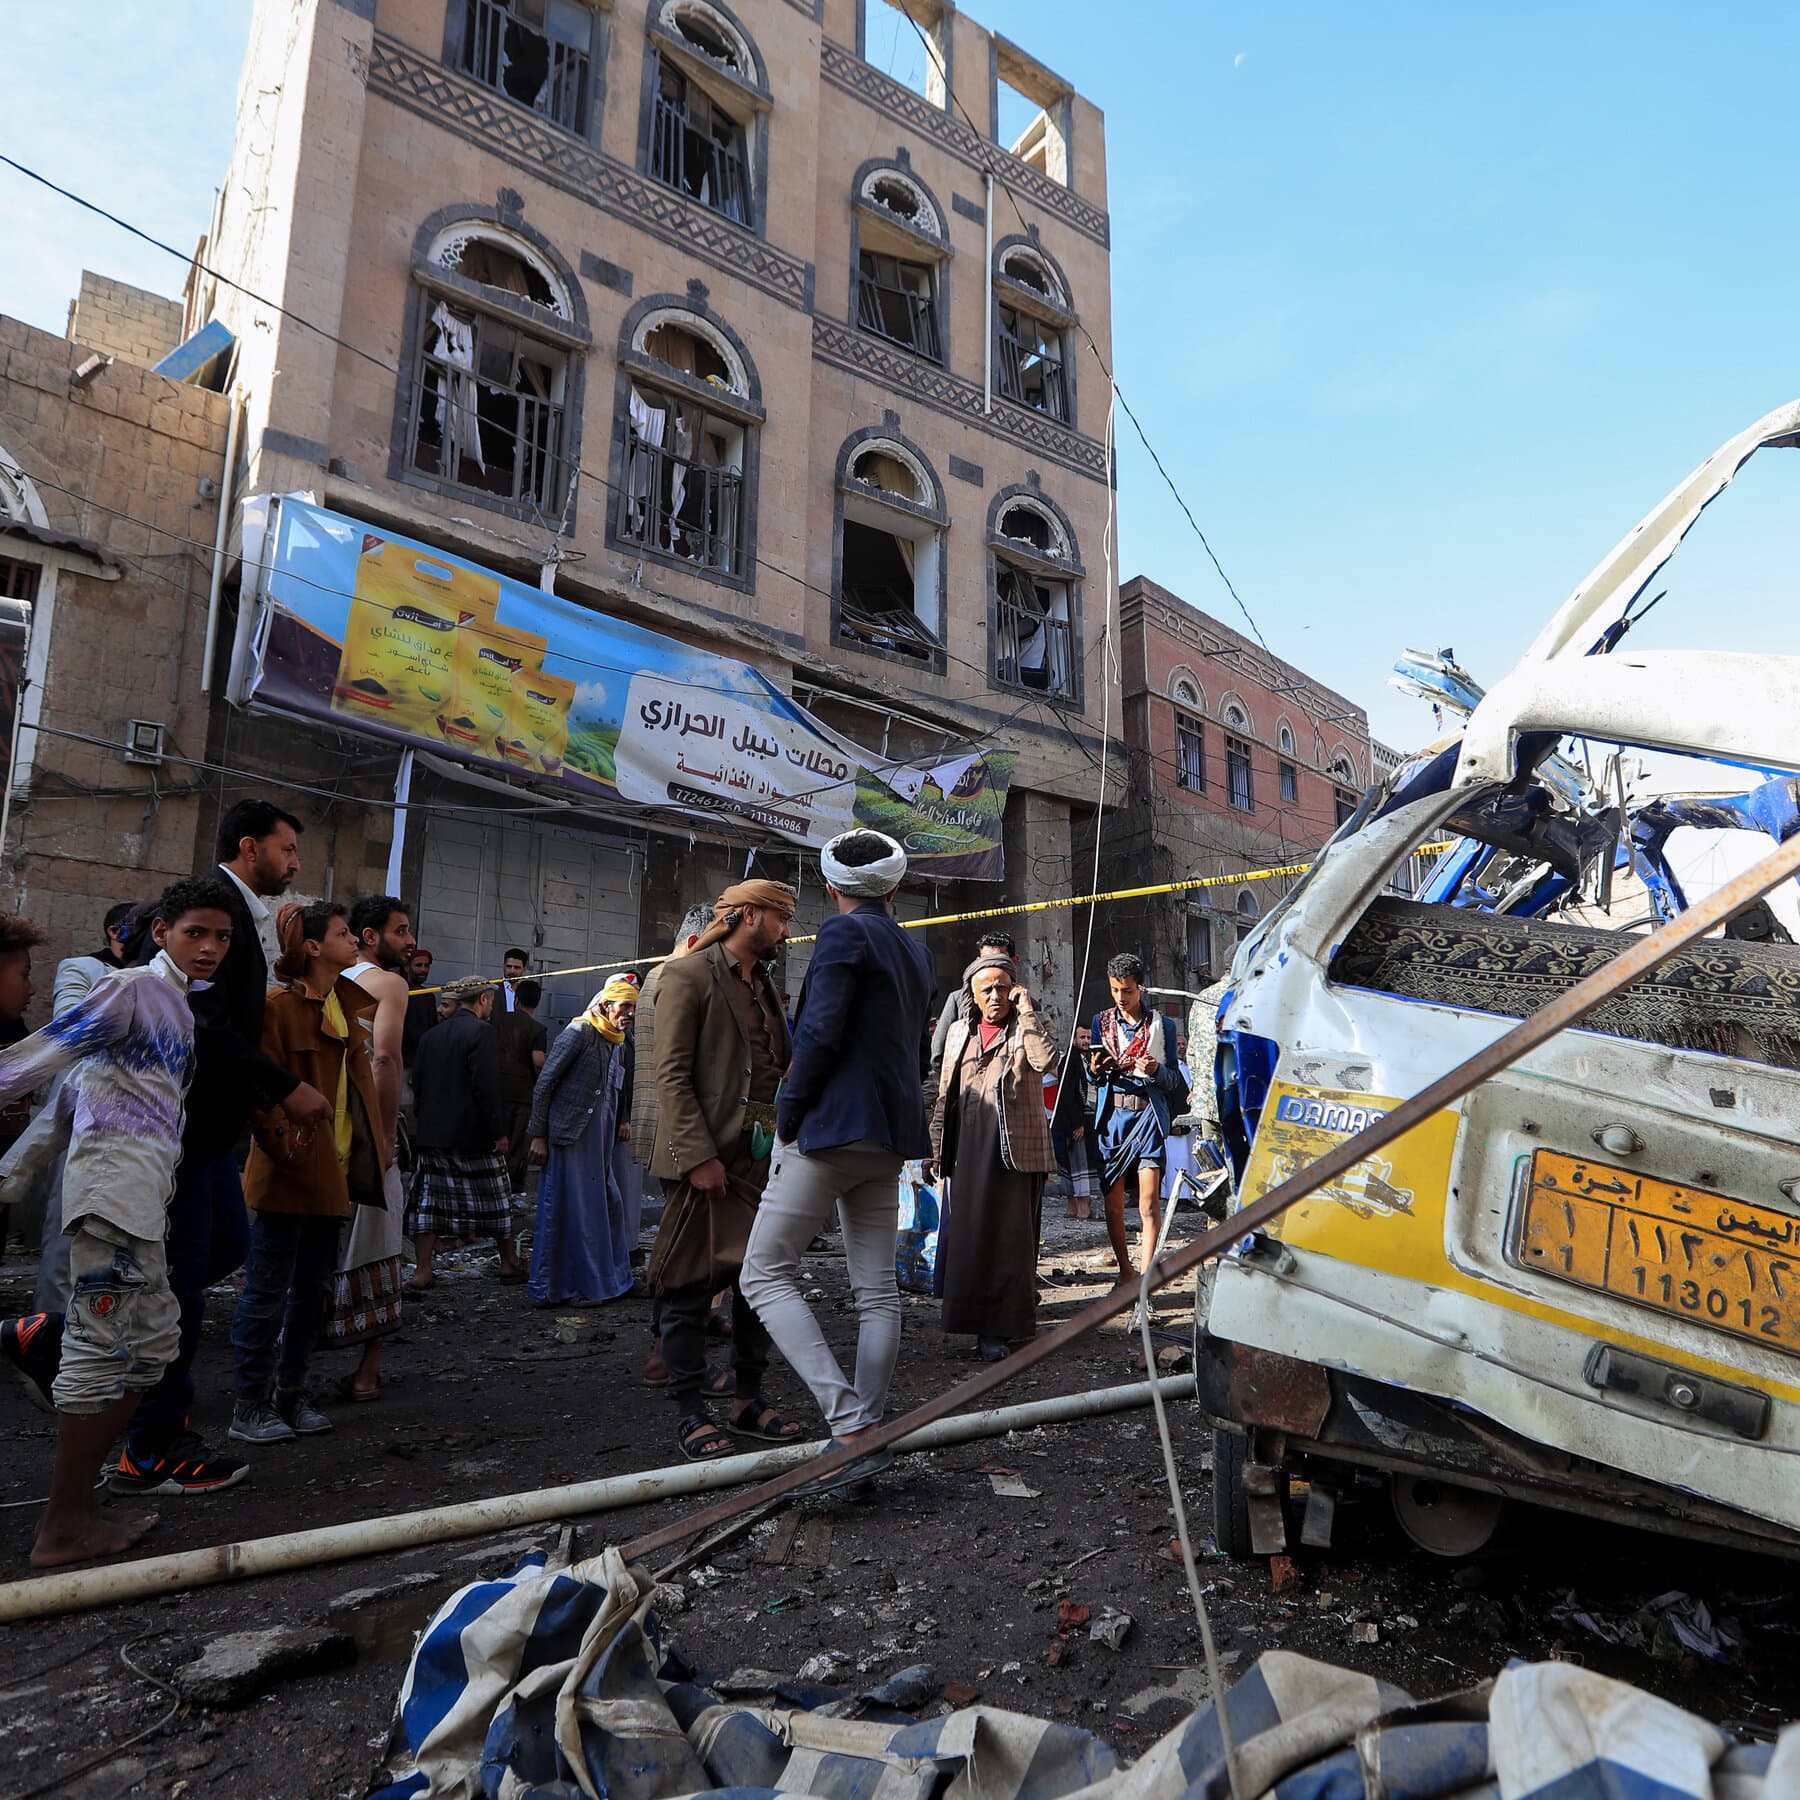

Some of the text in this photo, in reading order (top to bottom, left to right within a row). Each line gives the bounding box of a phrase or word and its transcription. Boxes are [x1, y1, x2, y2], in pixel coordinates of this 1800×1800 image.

[640, 699, 849, 781] محلات نبيل الحرازي
[1717, 1208, 1800, 1248] اليمن
[1558, 1244, 1781, 1337] 1 113012
